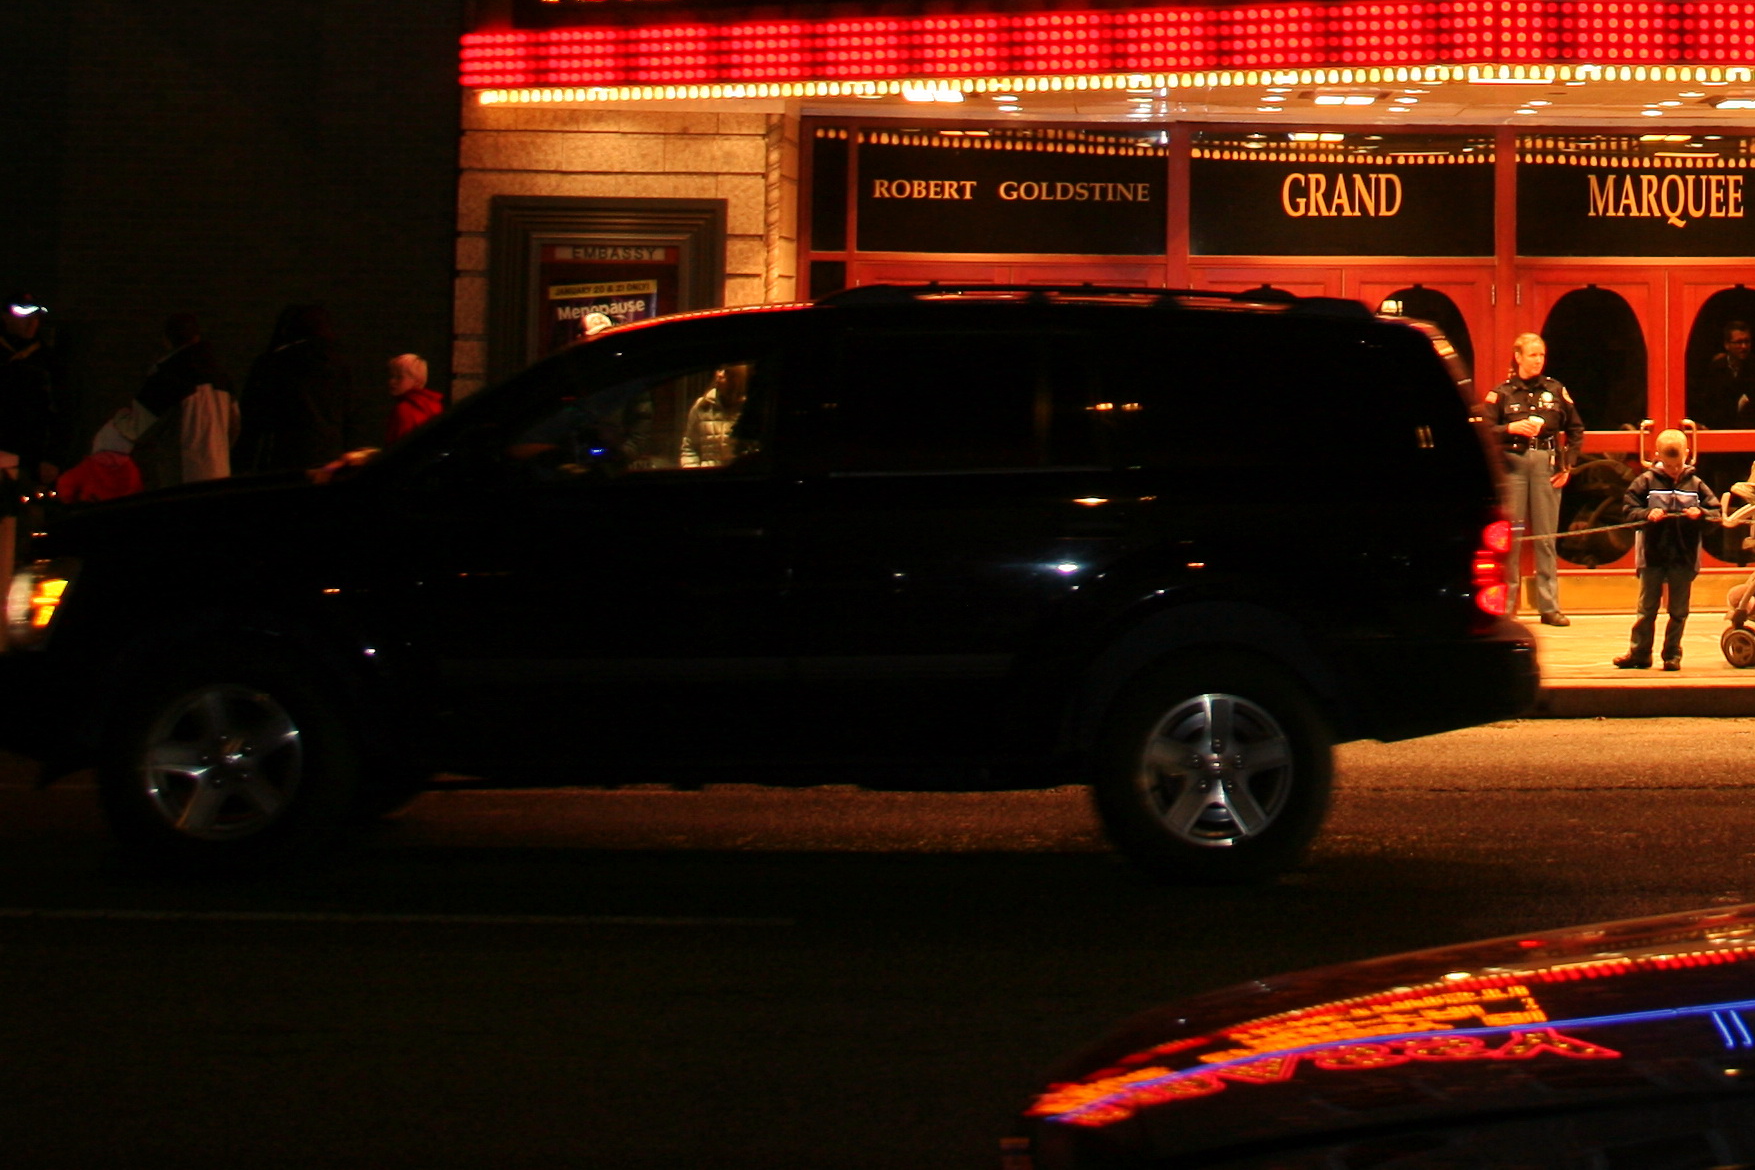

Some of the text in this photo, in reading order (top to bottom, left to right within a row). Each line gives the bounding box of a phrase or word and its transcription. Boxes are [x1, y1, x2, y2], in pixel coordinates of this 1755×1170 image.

[872, 178, 1150, 203] ROBERT GOLDSTINE
[1281, 172, 1403, 218] GRAND
[1587, 174, 1744, 228] MARQUEE
[572, 246, 656, 260] EMBASSY
